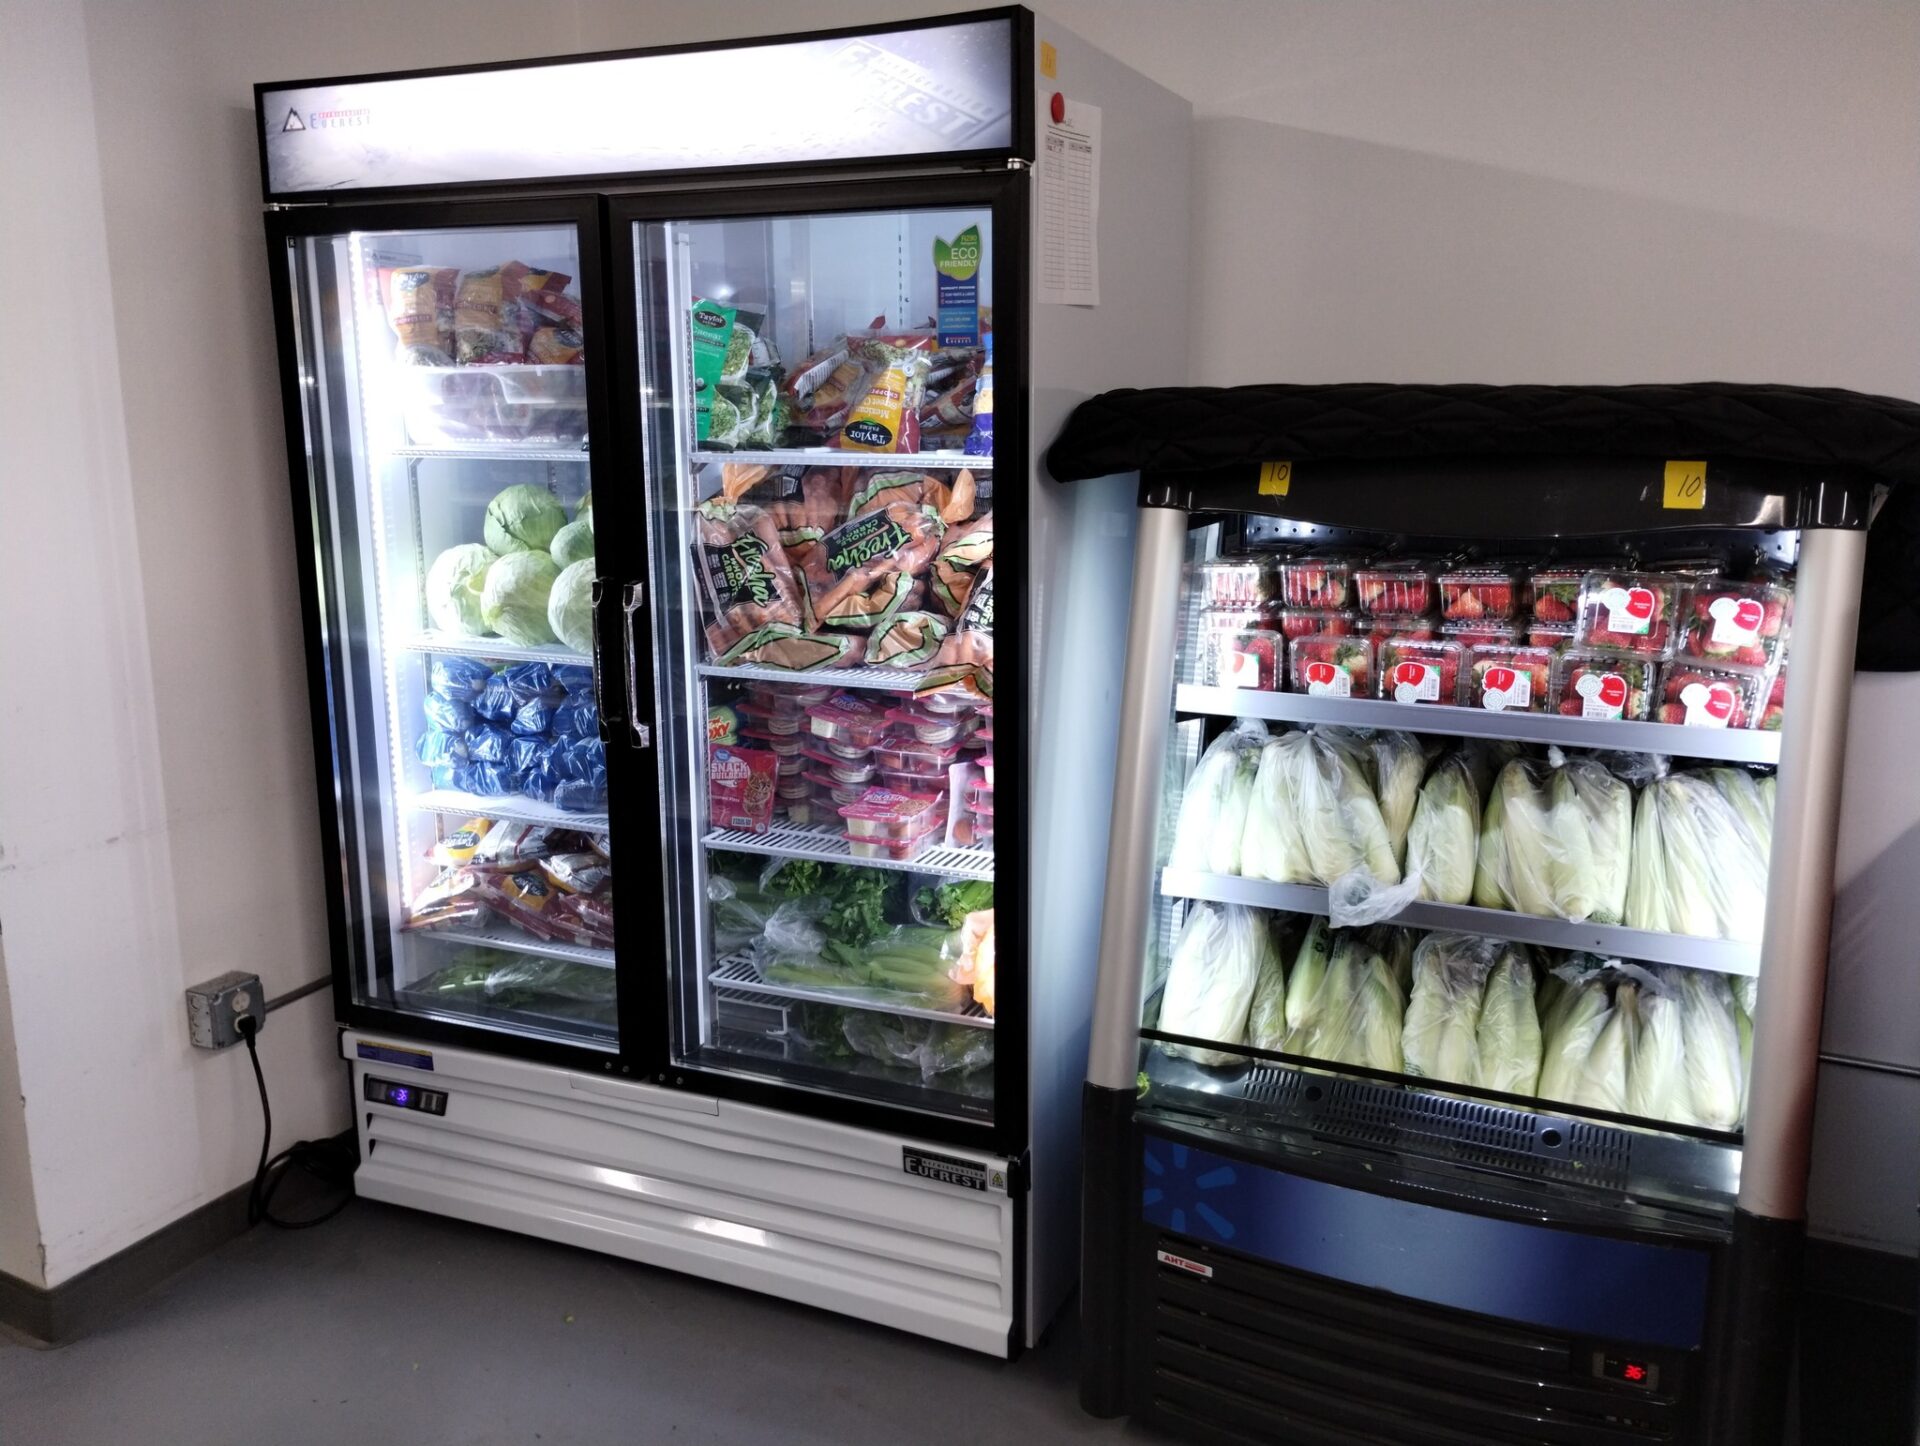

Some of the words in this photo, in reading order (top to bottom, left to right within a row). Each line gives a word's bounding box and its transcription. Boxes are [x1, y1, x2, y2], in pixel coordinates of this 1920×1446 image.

[951, 246, 978, 260] ECO
[940, 259, 978, 268] FRIENDLY
[850, 430, 886, 445] Taylor
[1269, 463, 1289, 482] 10
[1677, 474, 1702, 497] 10
[711, 761, 748, 774] SNACK
